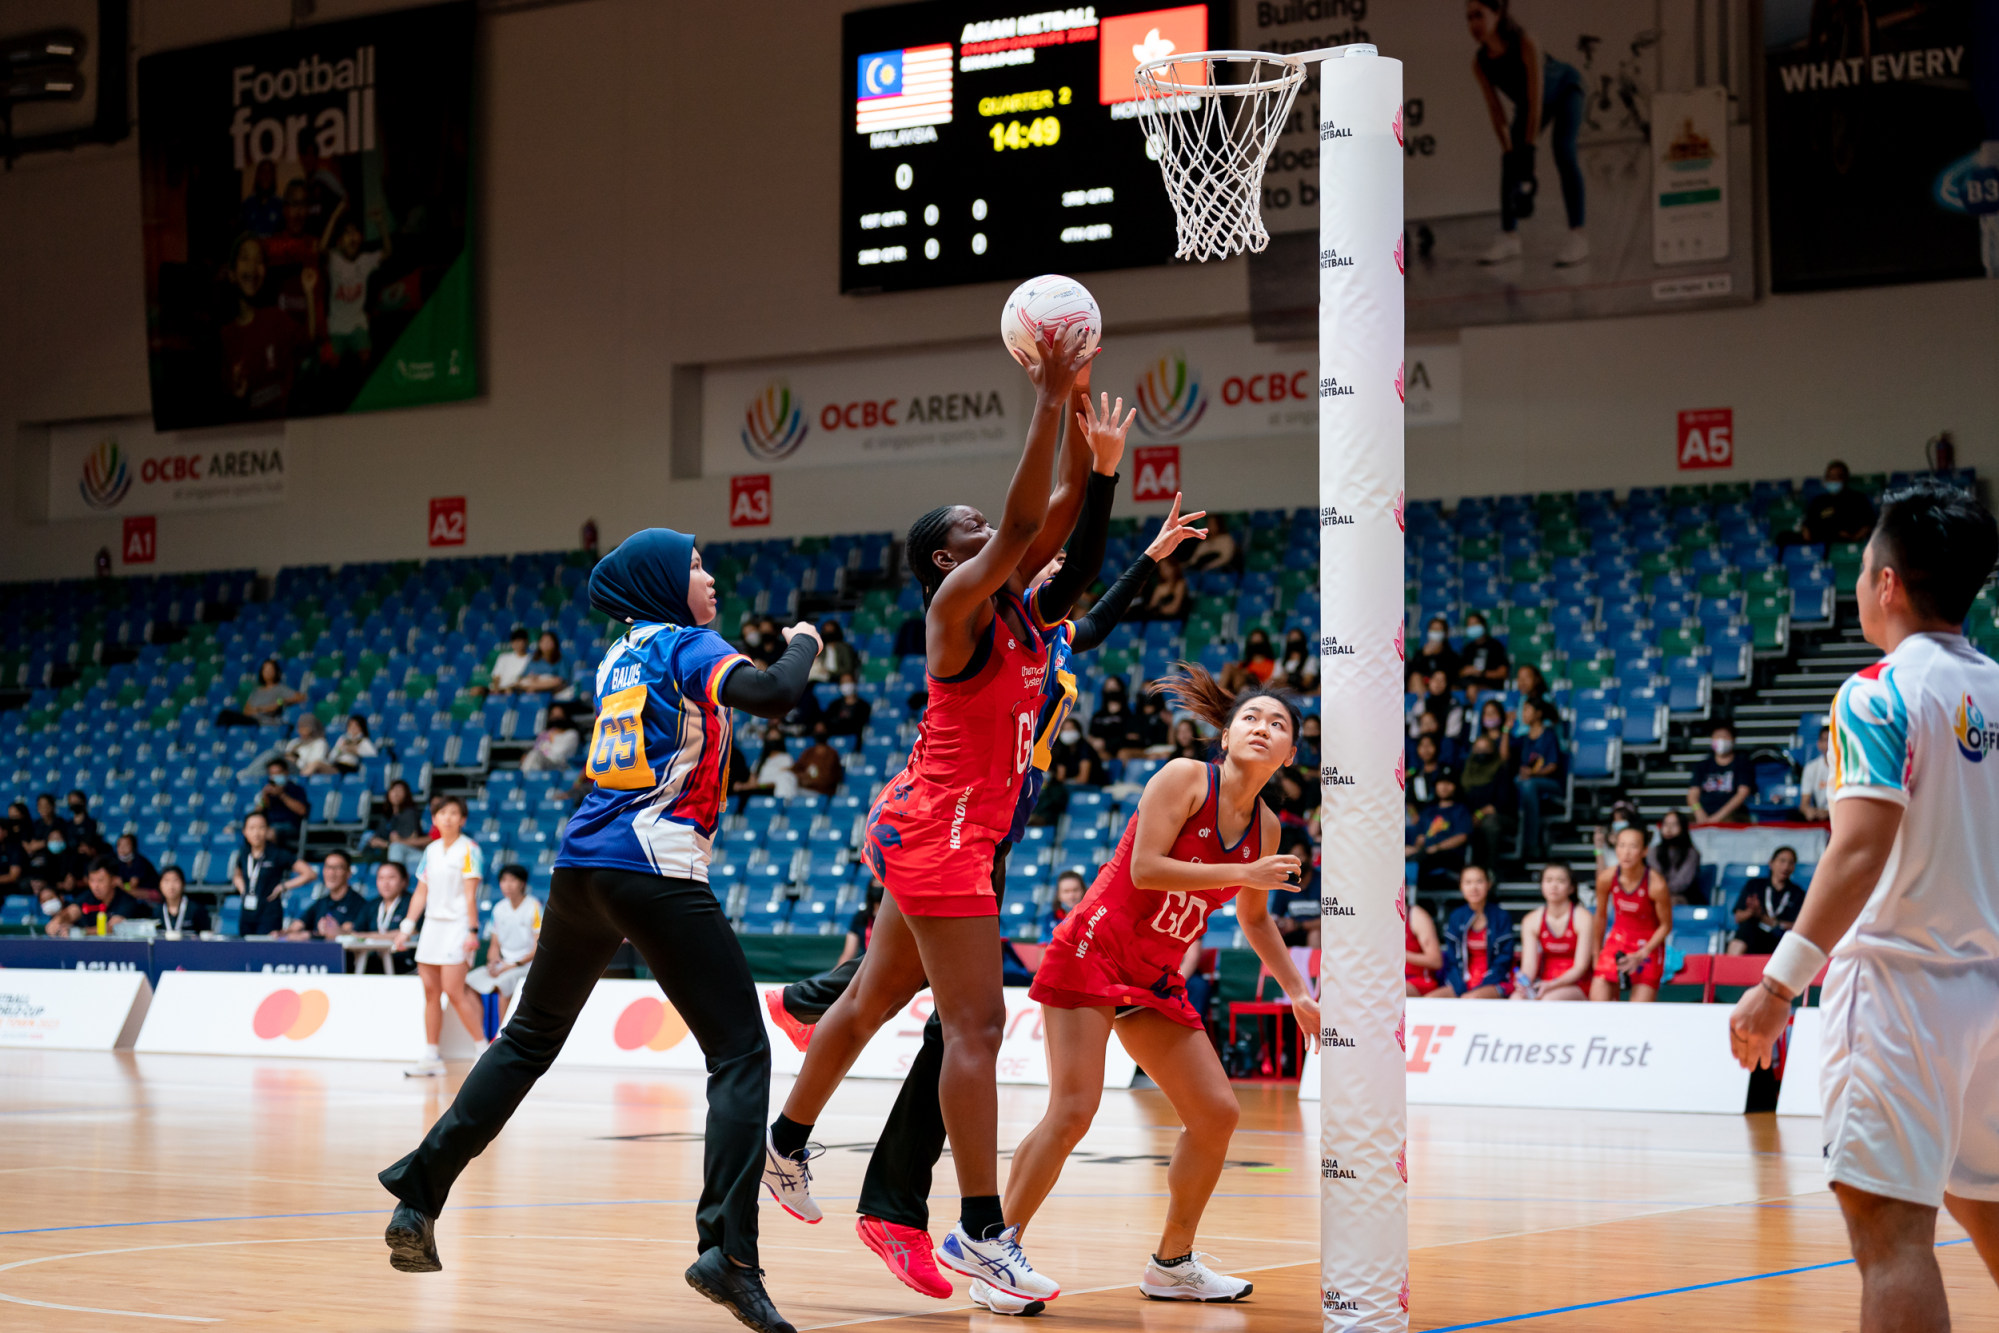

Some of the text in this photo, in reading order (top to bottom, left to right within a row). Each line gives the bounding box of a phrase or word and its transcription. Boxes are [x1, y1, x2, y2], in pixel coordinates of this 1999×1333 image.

[232, 44, 375, 107] Football
[1780, 45, 1964, 93] WHAT EVERY
[978, 86, 1072, 117] QUARTER 2
[229, 86, 375, 170] for all
[870, 125, 938, 150] MALAYSIA
[989, 116, 1061, 152] 14:49
[895, 163, 913, 191] 0
[924, 198, 988, 226] 0 0
[1264, 181, 1291, 209] to
[924, 232, 988, 260] 0 0
[1221, 370, 1310, 406] OCBC
[820, 390, 1005, 432] OCBC ARENA
[1681, 427, 1730, 464] A5
[141, 448, 284, 484] OCBC ARENA
[1135, 462, 1178, 496] A4
[732, 489, 769, 521] A3
[431, 511, 464, 540] A2
[127, 531, 151, 557] A1
[591, 708, 638, 776] GS
[1150, 890, 1208, 944] GD
